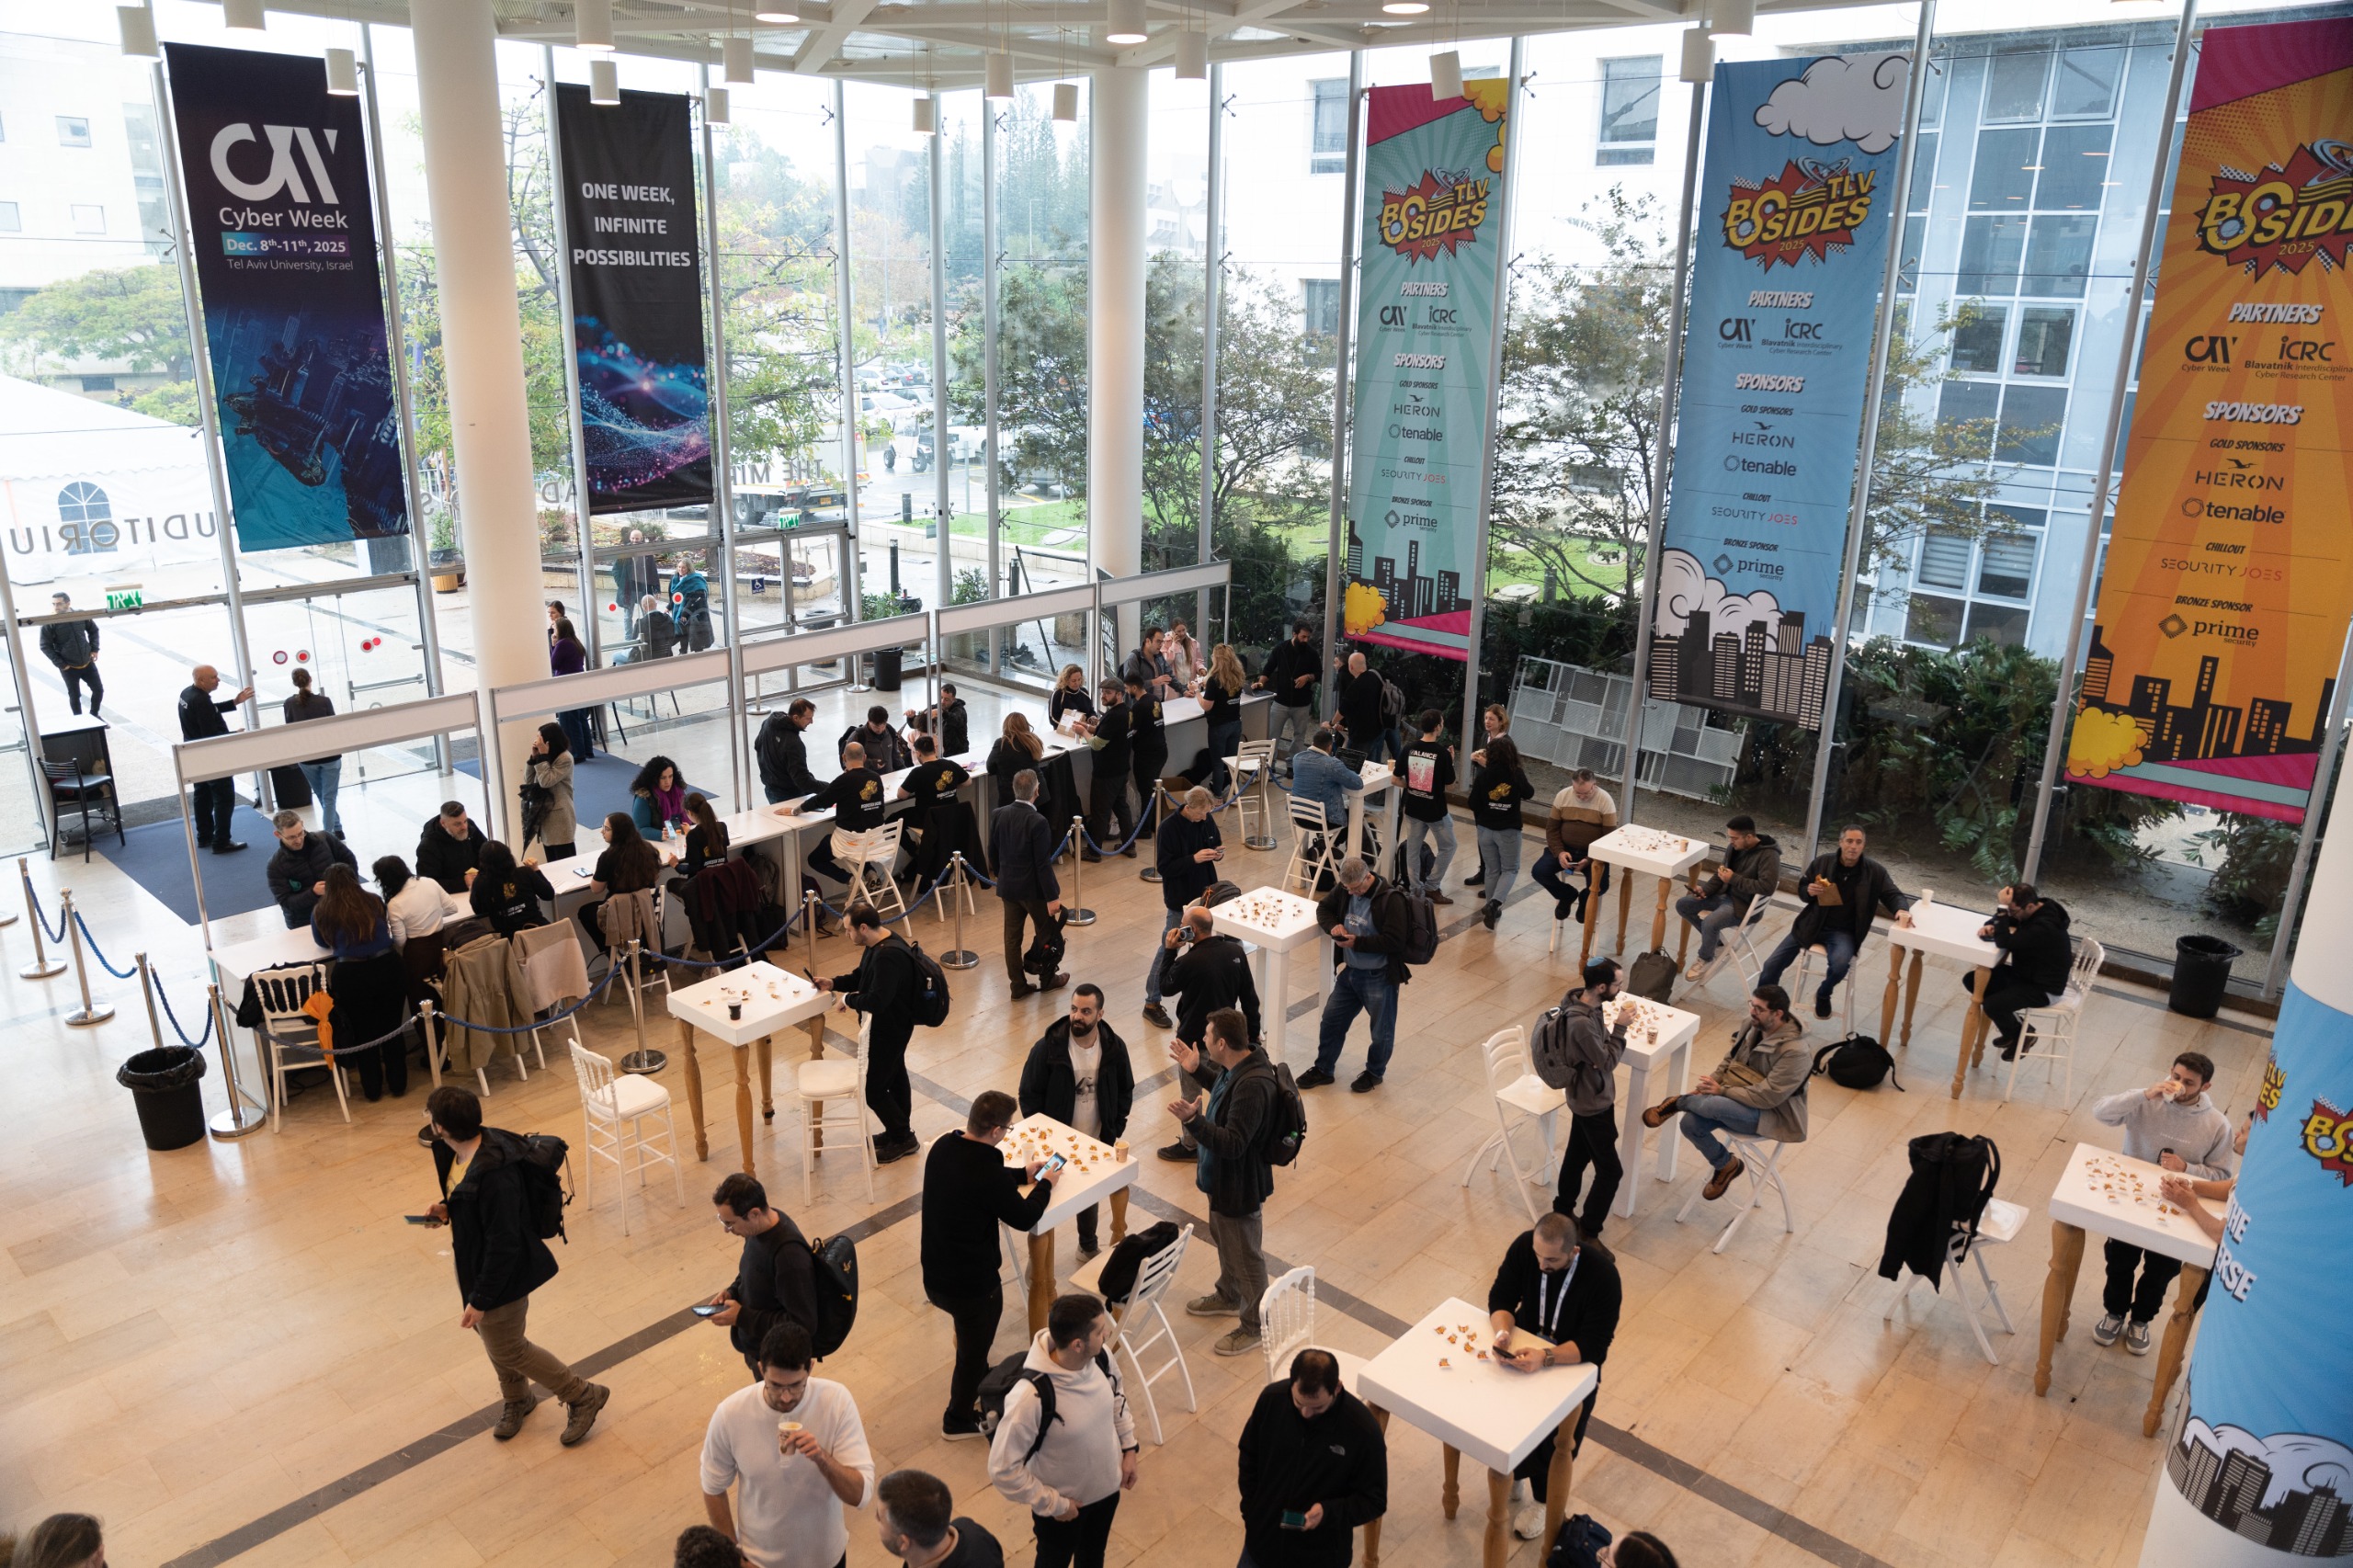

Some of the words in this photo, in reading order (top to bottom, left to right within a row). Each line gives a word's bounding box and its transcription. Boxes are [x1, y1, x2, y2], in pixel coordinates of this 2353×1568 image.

[1454, 177, 1489, 204] TLV
[1826, 169, 1876, 200] TLV
[582, 182, 619, 199] ONE
[621, 185, 675, 206] WEEK,
[219, 207, 283, 230] Cyber
[289, 210, 348, 228] Week
[594, 216, 667, 234] INFINITE
[226, 239, 257, 252] Dec.
[314, 241, 346, 253] 2025
[1421, 236, 1440, 248] 2025
[1779, 239, 1805, 252] 2025
[2278, 241, 2315, 256] 2025
[226, 259, 244, 269] Tel
[246, 259, 267, 269] Aviv
[270, 260, 324, 272] University,
[326, 261, 353, 270] Israel
[574, 249, 691, 267] POSSIBILITIES
[1400, 281, 1449, 297] PARTNERS
[1748, 290, 1814, 310] PARTNERS
[2228, 302, 2324, 325] PARTNERS
[1761, 338, 1795, 347] Blavatnik
[1393, 353, 1446, 369] SPONSORS
[2182, 363, 2206, 373] Cyber
[2208, 364, 2232, 373] Week
[2245, 360, 2293, 369] Blavatnik
[1735, 373, 1805, 393] SPONSORS
[2256, 370, 2278, 379] Cyber
[2279, 371, 2316, 381] Research
[1413, 381, 1438, 390] SPONSORS
[1393, 403, 1440, 417] HERON
[1741, 404, 1757, 414] GOLD
[1759, 406, 1793, 415] SPONSORS
[2202, 401, 2304, 426] SPONSORS
[1402, 426, 1443, 441] tenable
[1732, 432, 1794, 449] HERON
[2210, 438, 2234, 449] GOLD
[2235, 439, 2285, 452] SPONSORS
[1404, 456, 1426, 465] CHILLOUT
[1741, 458, 1796, 476] tenable
[1423, 474, 1446, 483] JOES
[2195, 471, 2285, 491] HERON
[1392, 496, 1410, 505] BRONZE
[1410, 498, 1432, 507] SPONSOR
[1743, 493, 1771, 502] CHILLOUT
[1767, 513, 1798, 526] JOES
[2206, 501, 2285, 524] tenable
[1403, 513, 1438, 528] prime
[1723, 539, 1748, 548] BRONZE
[1748, 540, 1779, 551] SPONSOR
[2206, 542, 2246, 554] CHILLOUT
[1737, 559, 1784, 575] prime
[2239, 566, 2282, 582] JOES
[2175, 596, 2210, 608] BRONZE
[2211, 599, 2253, 612] SPONSOR
[2192, 619, 2259, 641] prime
[2223, 637, 2256, 647] security
